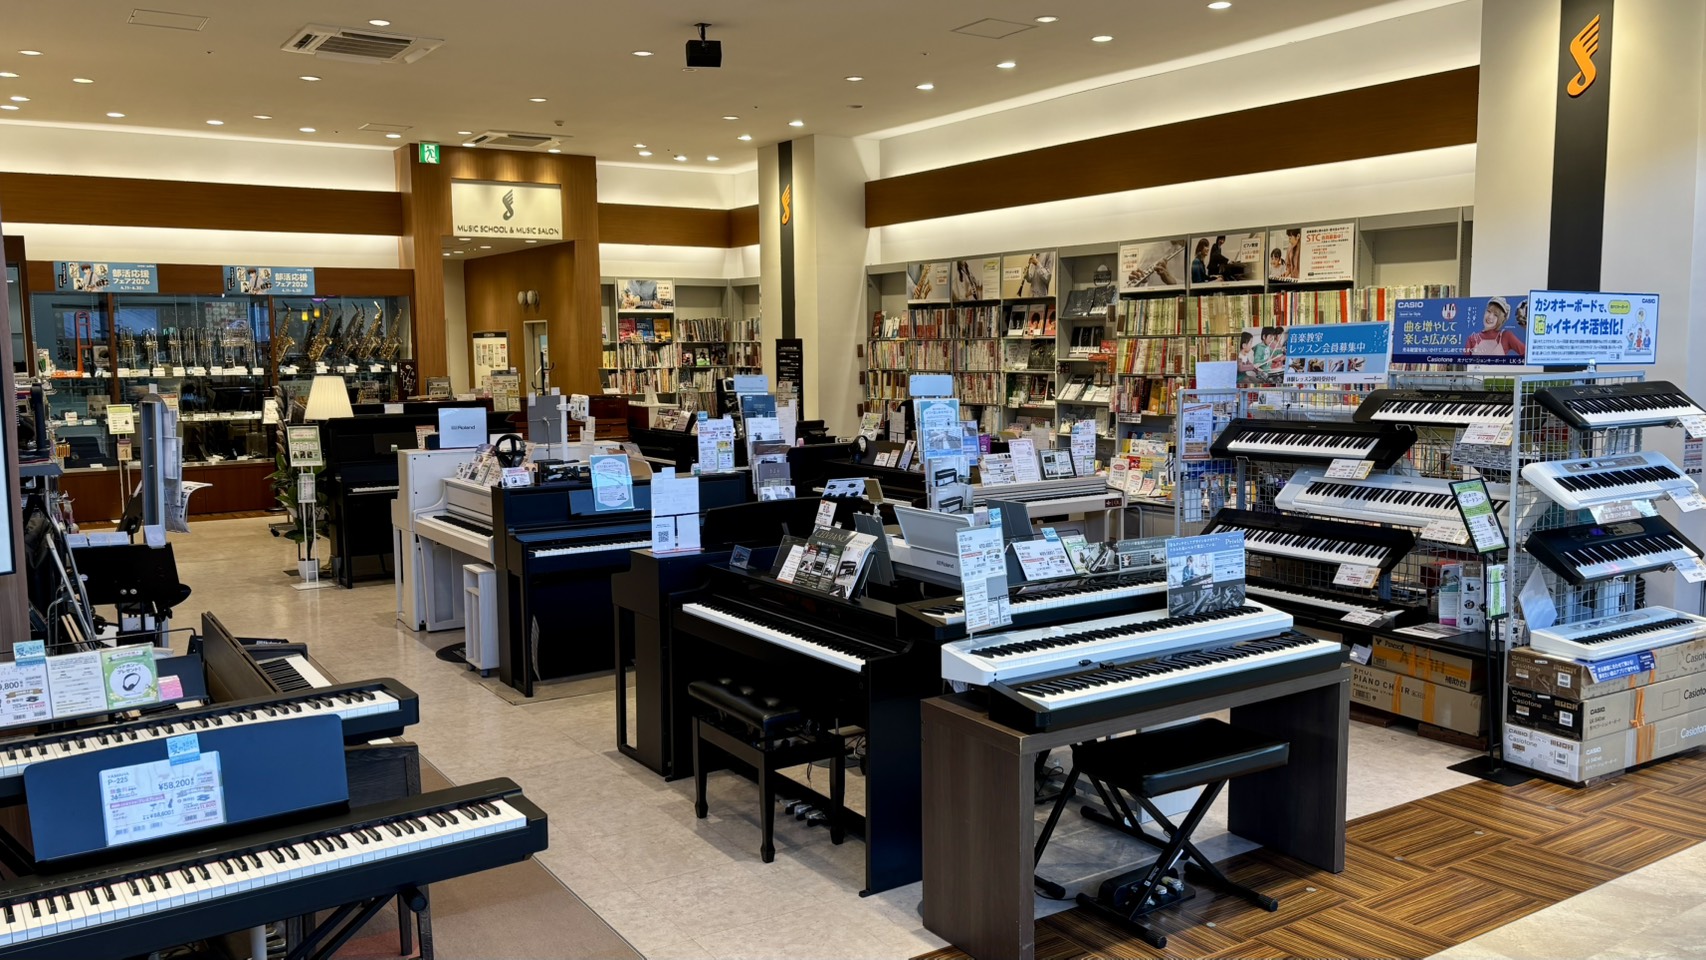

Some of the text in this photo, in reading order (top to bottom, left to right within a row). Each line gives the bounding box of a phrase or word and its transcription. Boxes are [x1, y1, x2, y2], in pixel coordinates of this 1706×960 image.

[480, 225, 507, 234] SCHOOL
[509, 226, 514, 234] &
[538, 227, 559, 235] SALON
[1306, 233, 1321, 243] STC
[1397, 301, 1424, 309] CASIO
[1403, 320, 1456, 332] 曲を増やして
[1290, 332, 1324, 343] 音楽教室
[1403, 334, 1462, 345] 楽しさ広がる!
[1289, 342, 1366, 354] レッスン会員募集中
[1511, 660, 1541, 672] Casiotone
[1353, 673, 1381, 688] PIANO
[1382, 679, 1411, 696] CHIR
[1512, 689, 1532, 698] CASIO
[1511, 695, 1542, 709] Casiotone
[1589, 706, 1606, 715] CASIO
[1508, 728, 1528, 737] CASIO
[1508, 734, 1538, 748] Casiotone
[1585, 746, 1602, 755] CASIO
[107, 777, 129, 785] P-225
[158, 778, 191, 791] ¥58,200
